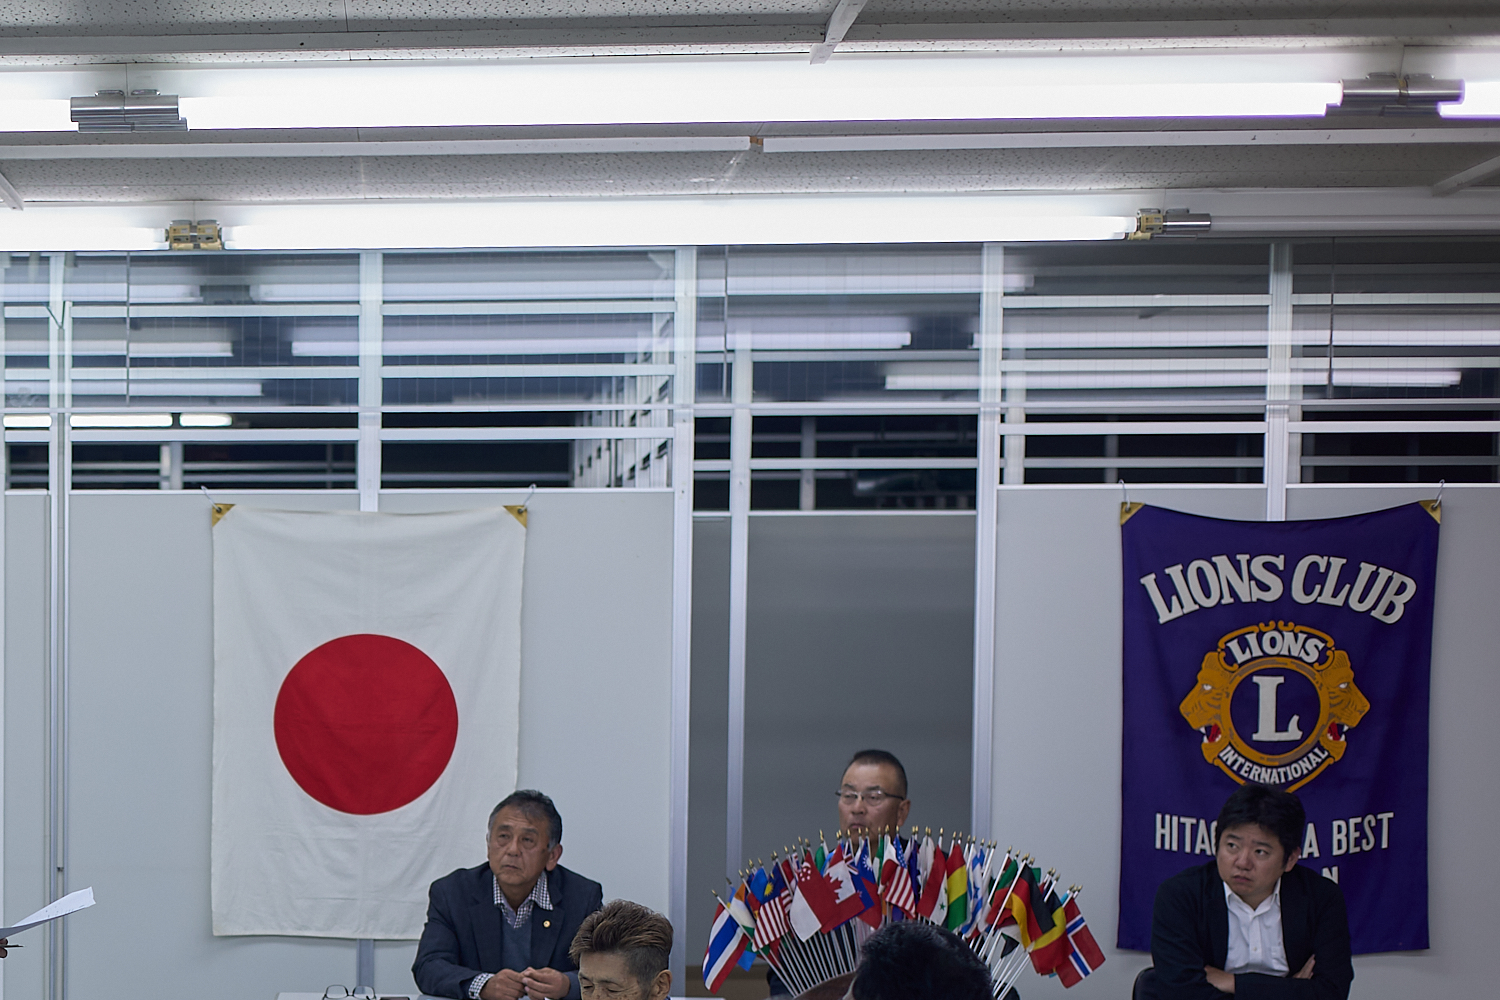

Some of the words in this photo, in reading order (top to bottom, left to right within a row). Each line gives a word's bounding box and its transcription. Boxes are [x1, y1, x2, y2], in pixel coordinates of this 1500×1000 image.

[1140, 554, 1285, 624] LIONS
[1291, 554, 1417, 624] CLUB
[1226, 630, 1325, 664] LIONS
[1252, 675, 1303, 741] L
[1218, 746, 1328, 784] INTERNATIONAL
[1332, 812, 1394, 856] BEST
